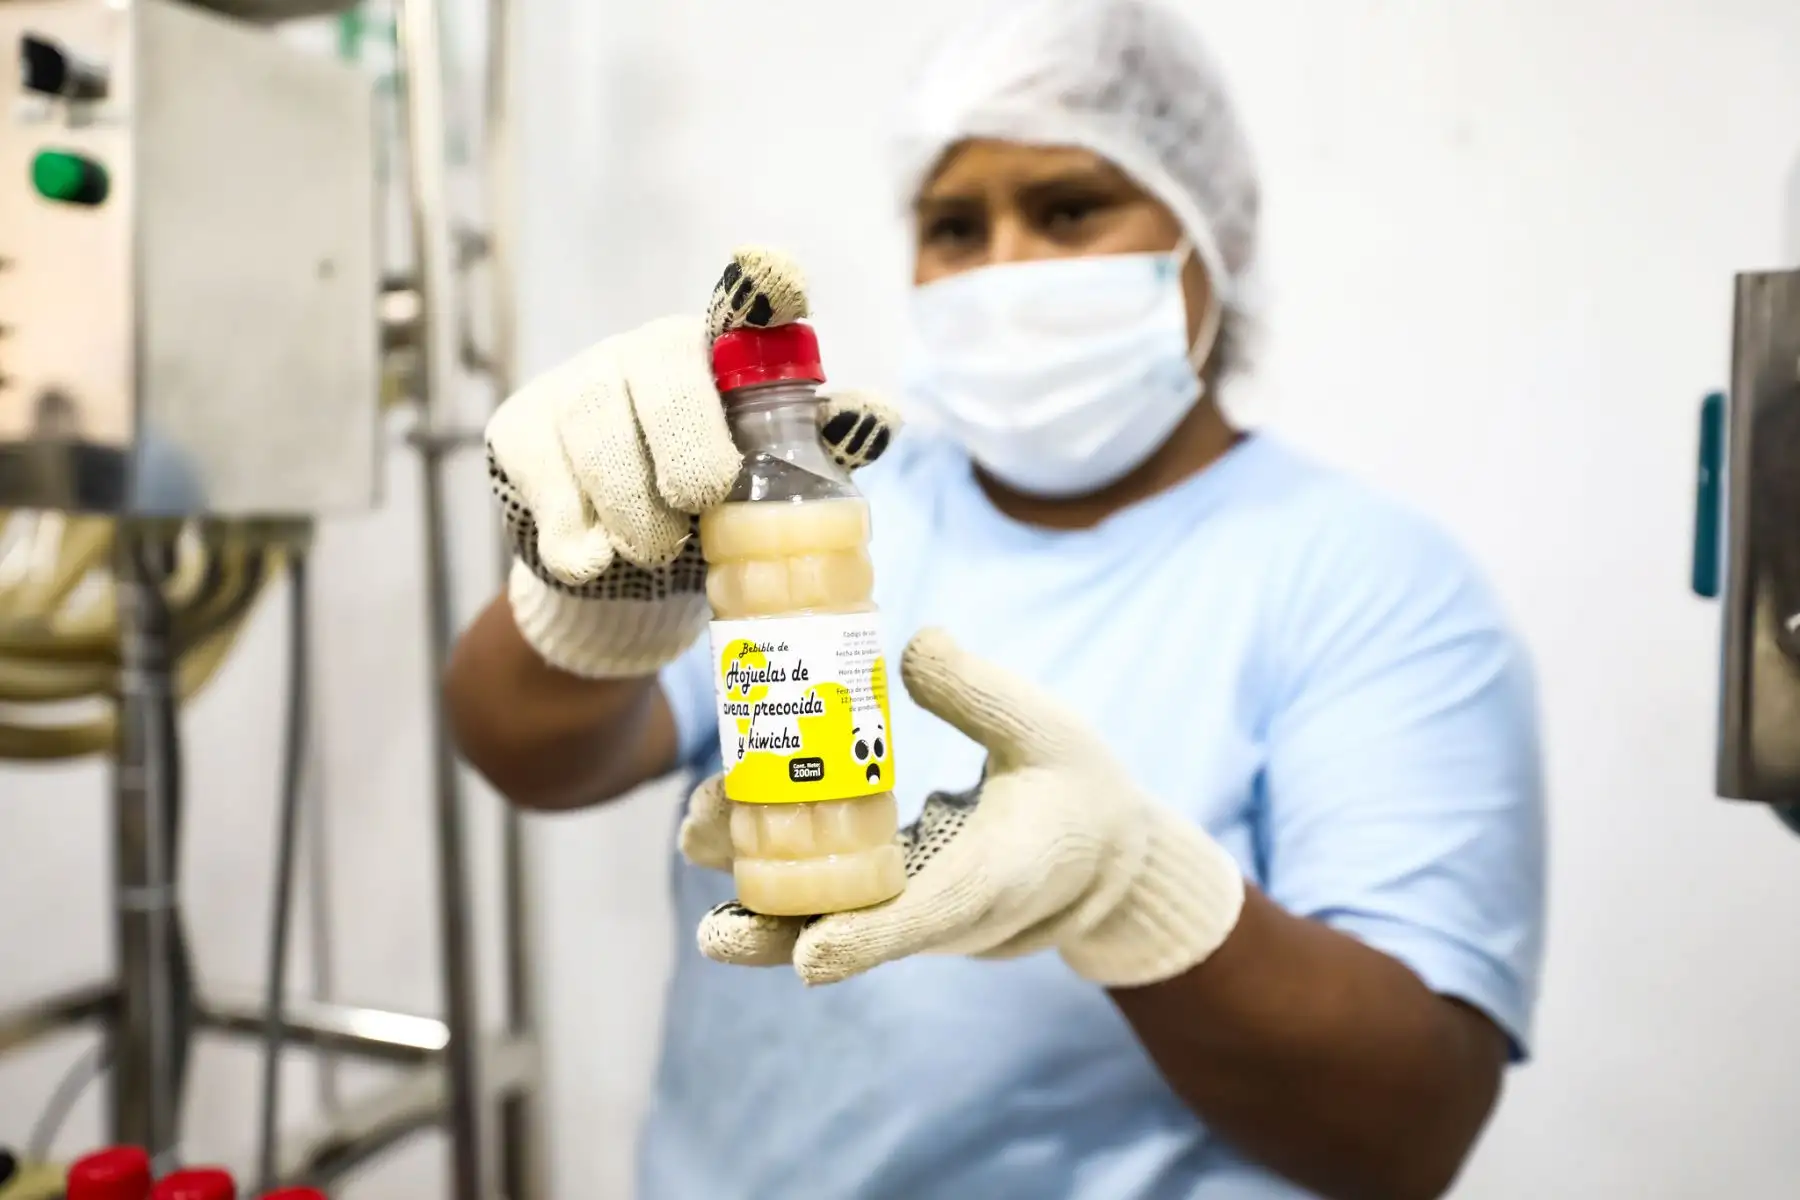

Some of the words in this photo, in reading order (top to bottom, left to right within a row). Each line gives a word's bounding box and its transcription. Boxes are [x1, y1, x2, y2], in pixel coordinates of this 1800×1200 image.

[739, 642, 774, 658] Bebible
[778, 642, 789, 652] de
[726, 661, 786, 694] Hojuelas
[792, 659, 809, 681] de
[724, 702, 749, 716] avena
[752, 692, 823, 725] precocida
[738, 736, 745, 760] y
[748, 727, 800, 749] kiwicha
[794, 768, 820, 778] 200ml
